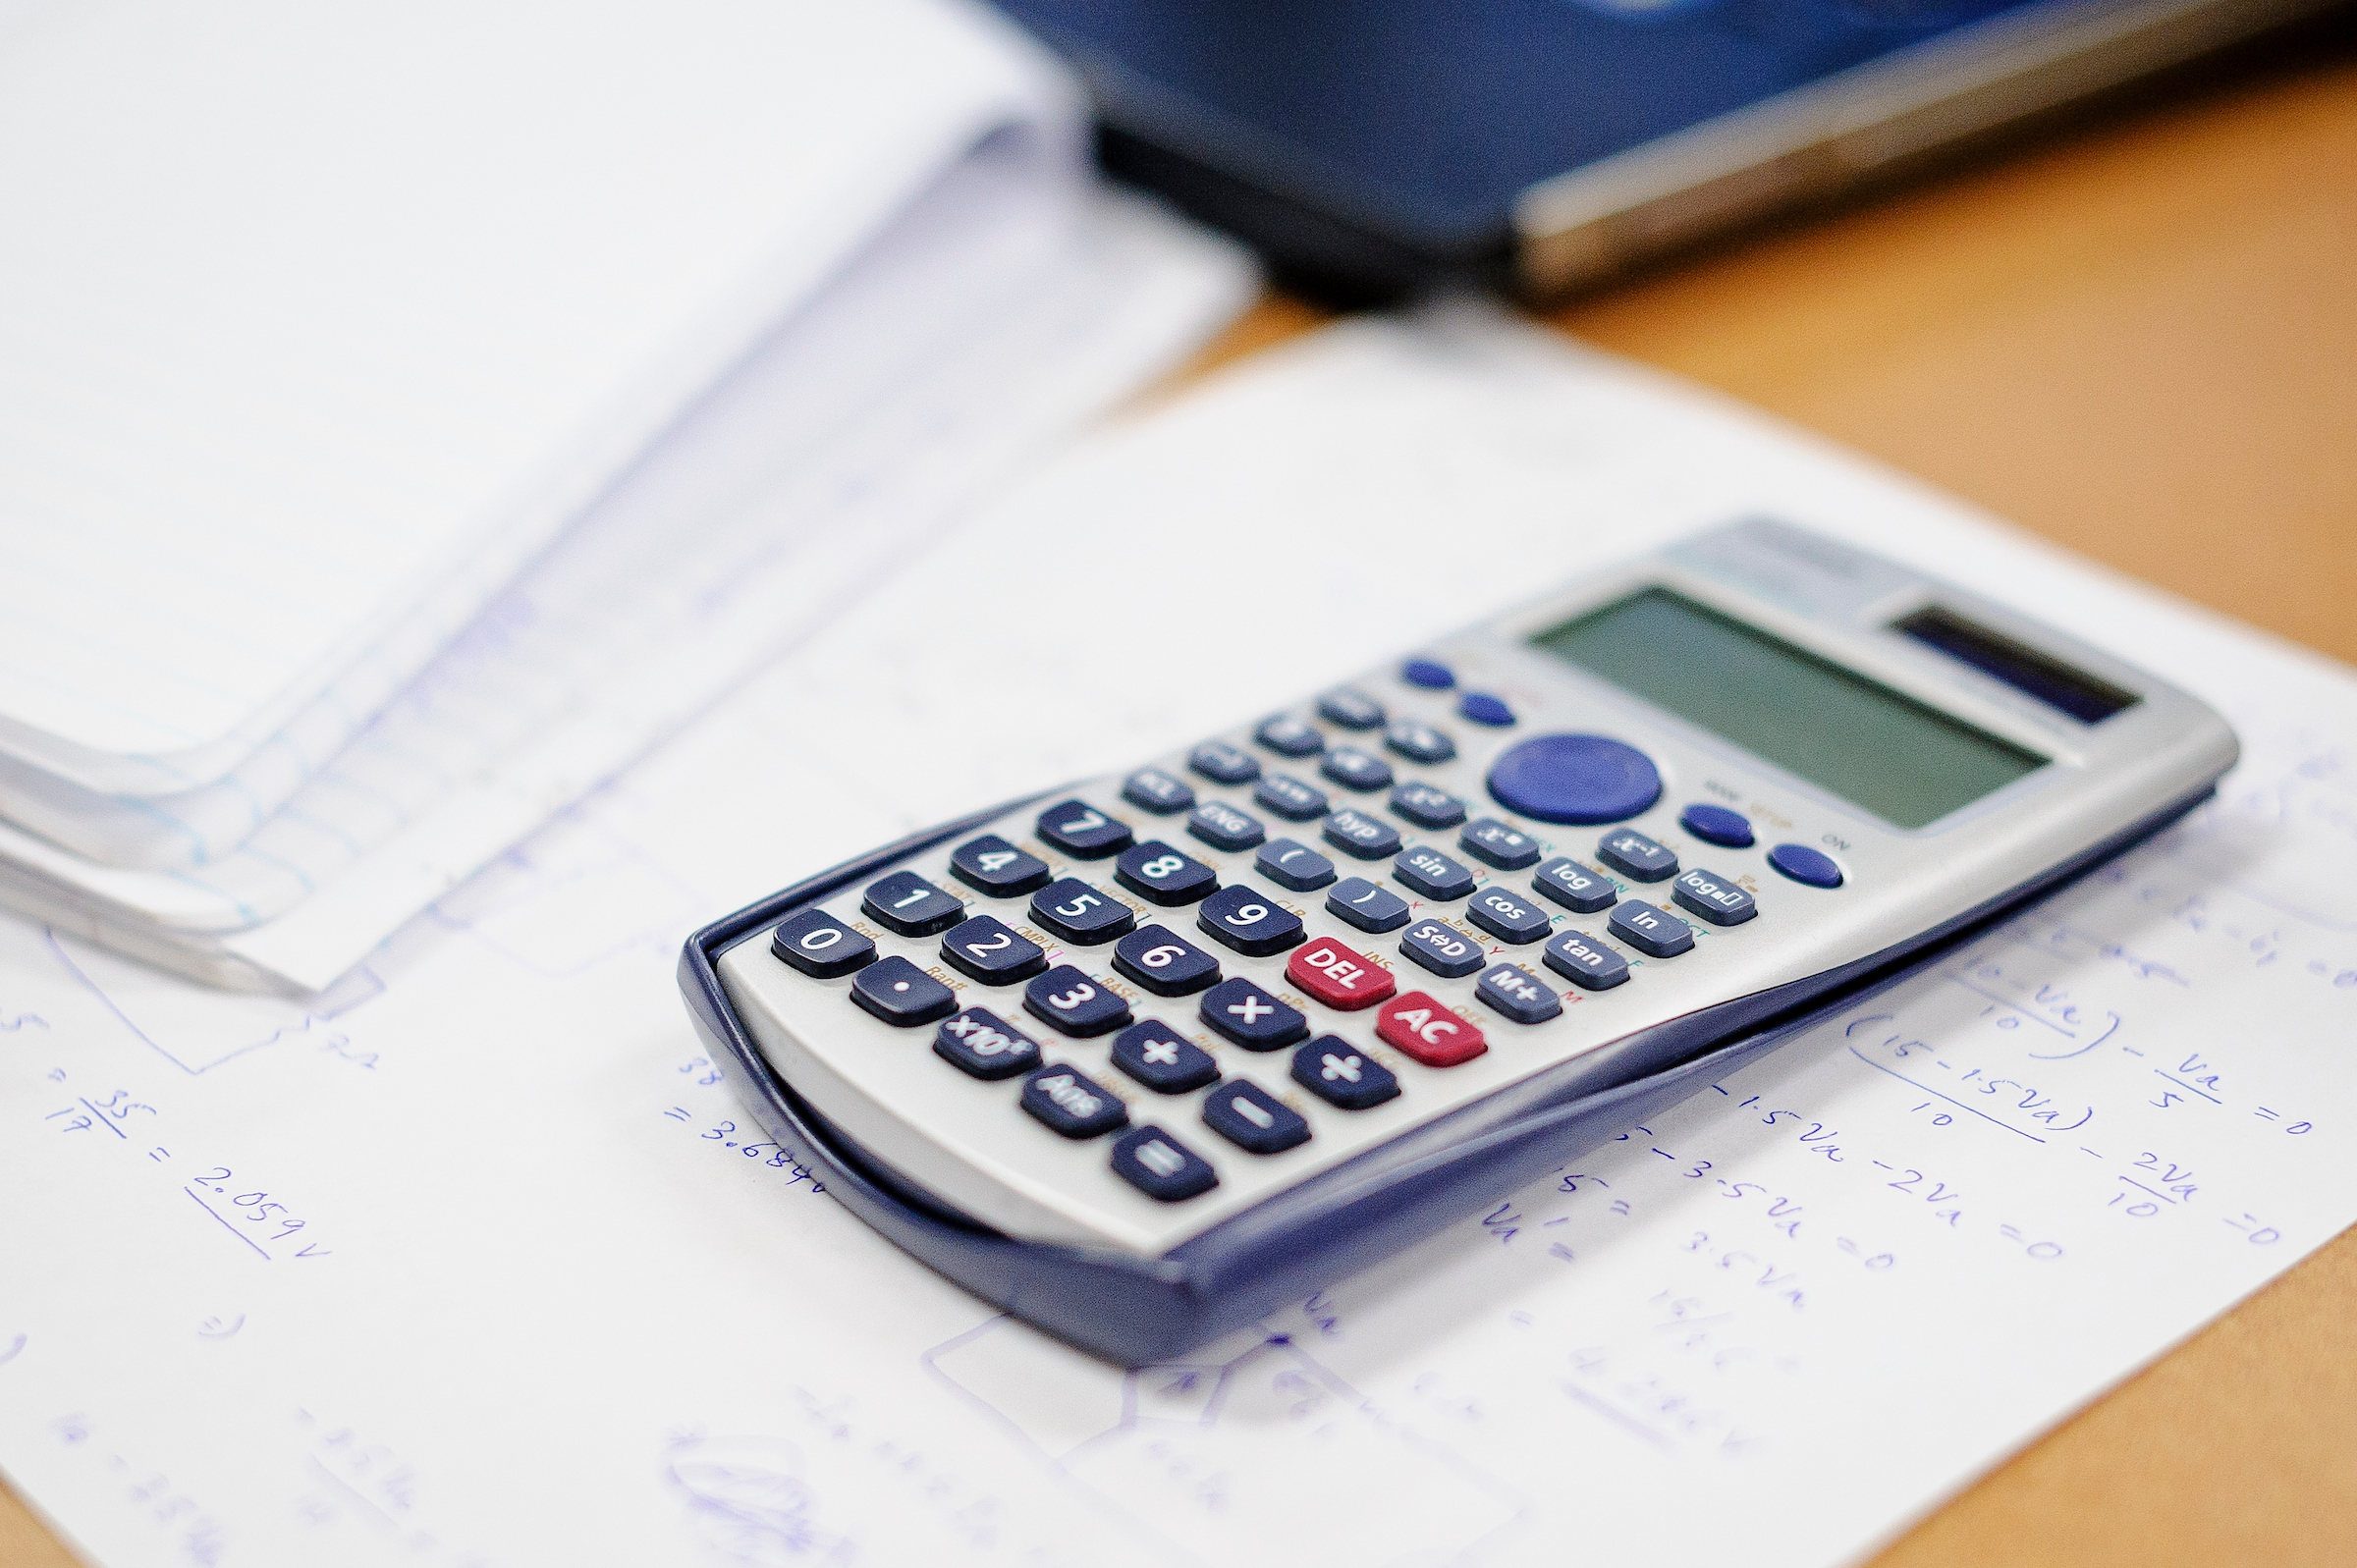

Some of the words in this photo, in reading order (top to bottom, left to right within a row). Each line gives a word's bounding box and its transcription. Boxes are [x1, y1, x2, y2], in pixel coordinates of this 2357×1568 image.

[1062, 813, 1105, 837] 7
[1198, 805, 1249, 833] ENG
[1335, 811, 1379, 838] hyp
[1822, 835, 1851, 851] ON
[978, 850, 1018, 872] 4
[1141, 854, 1185, 879] 8
[1410, 854, 1447, 877] sin
[1551, 864, 1592, 891] log
[893, 888, 931, 909] 1
[1055, 893, 1102, 917] 5
[1276, 899, 1306, 917] CLR
[1484, 894, 1526, 920] cos
[1224, 903, 1269, 926] 9
[1551, 914, 1566, 925] E
[1631, 911, 1660, 930] ln
[800, 928, 843, 950] 0
[850, 922, 884, 941] Rnd
[965, 931, 1013, 958] 2
[1140, 945, 1186, 968] 6
[1489, 946, 1506, 956] Y
[1562, 938, 1604, 967] tan
[1303, 947, 1366, 990] DEL
[1362, 950, 1395, 970] INS
[925, 965, 968, 991] Ran#
[1489, 969, 1538, 1001] M+
[1048, 982, 1097, 1010] 3
[1561, 991, 1584, 1004] M
[1393, 1008, 1459, 1045] AC
[1035, 1073, 1103, 1119] Ans
